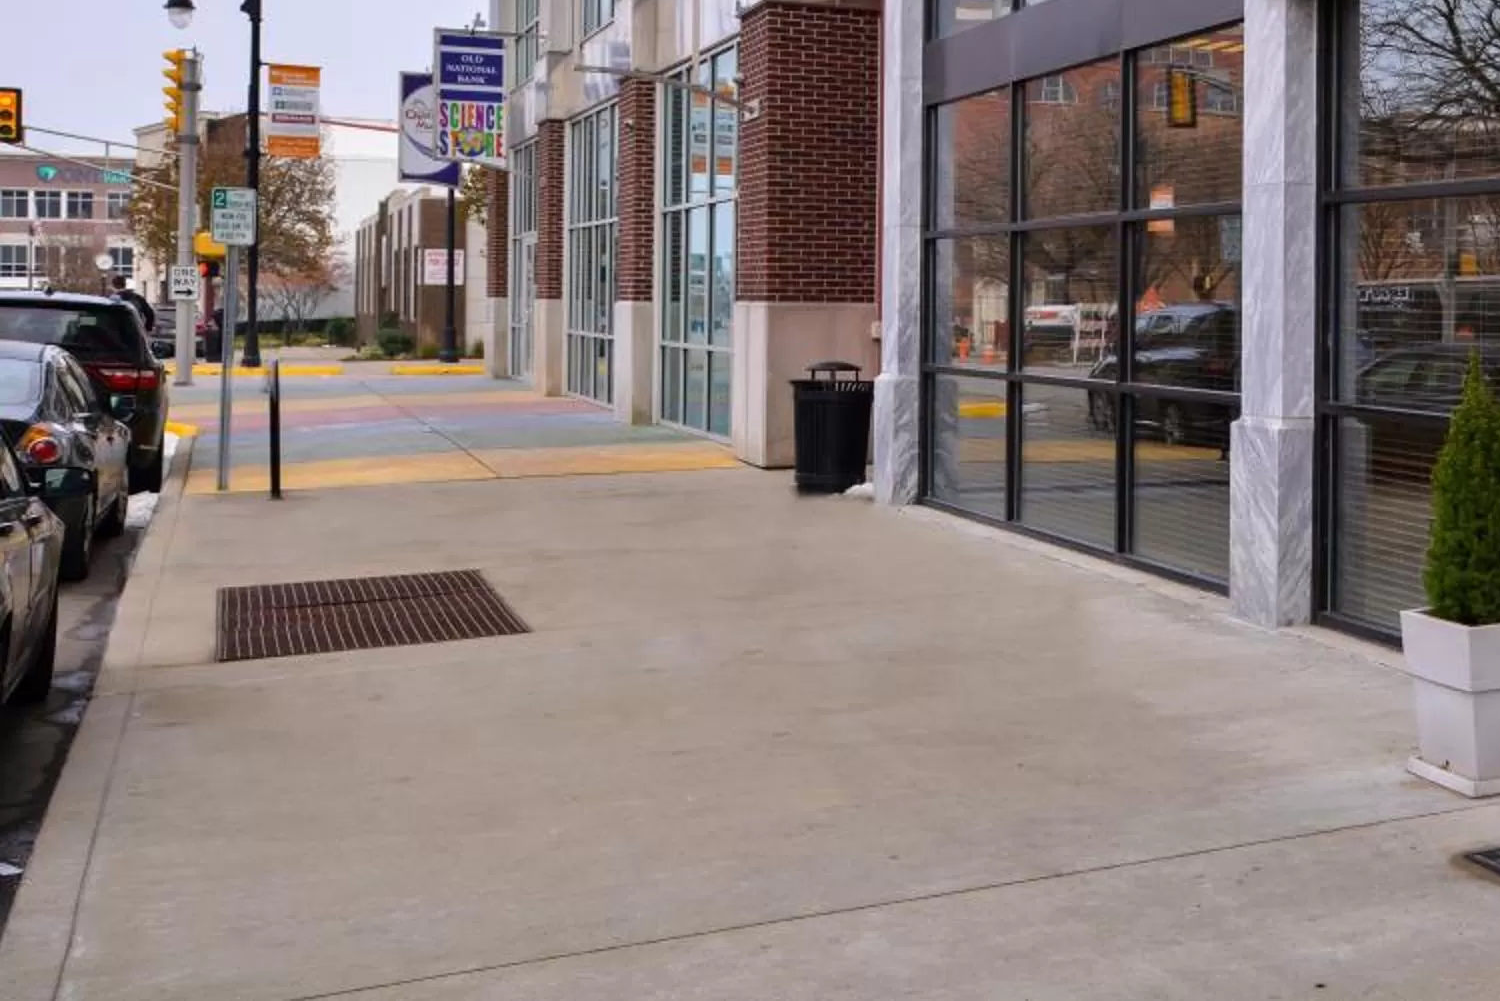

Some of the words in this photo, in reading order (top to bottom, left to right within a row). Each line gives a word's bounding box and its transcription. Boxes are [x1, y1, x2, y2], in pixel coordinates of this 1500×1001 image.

[461, 55, 484, 64] OLD
[446, 64, 497, 75] NATIONAL
[457, 75, 487, 85] BANK
[439, 102, 505, 132] SCIENCE
[215, 192, 225, 205] 2
[174, 268, 196, 277] ONE
[174, 278, 196, 287] WAY
